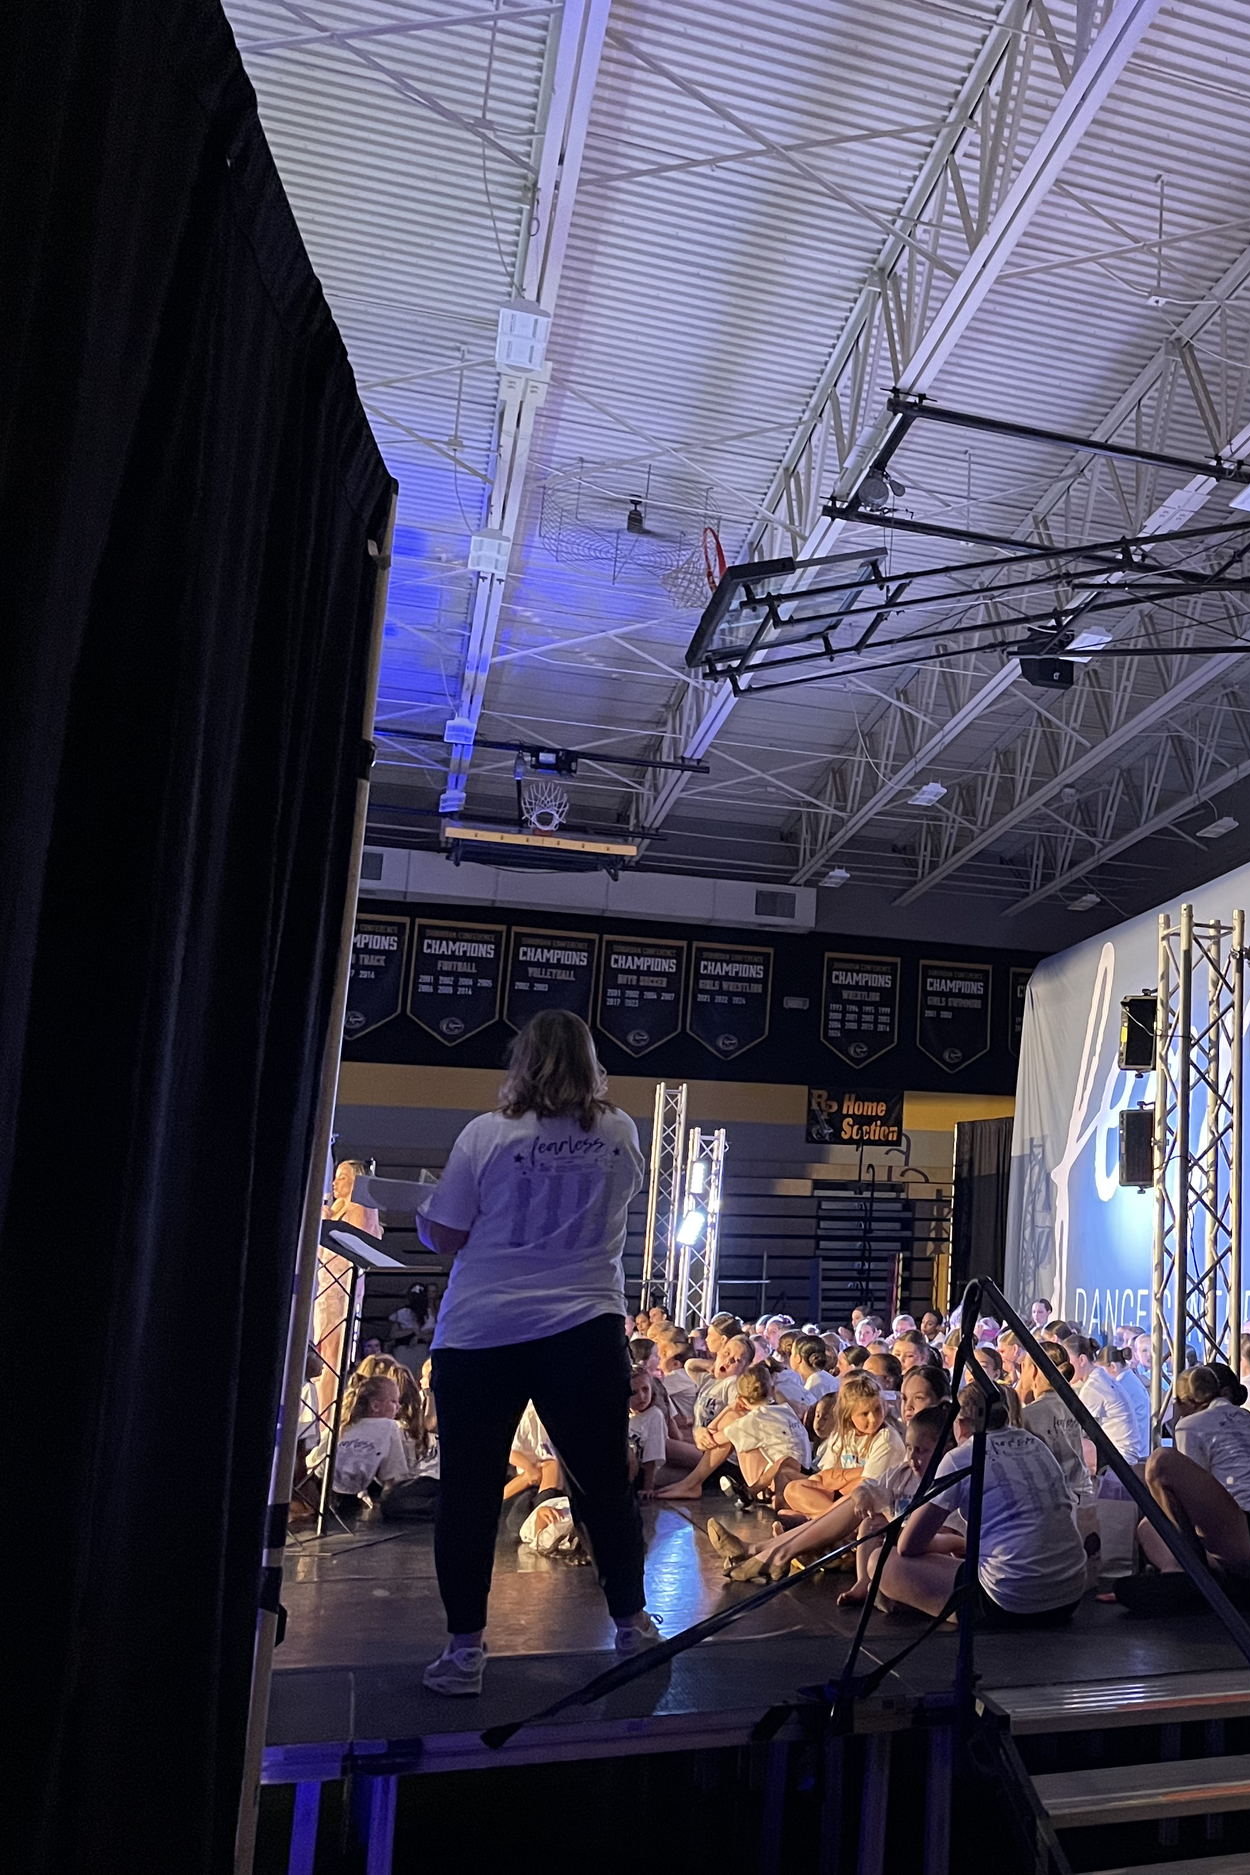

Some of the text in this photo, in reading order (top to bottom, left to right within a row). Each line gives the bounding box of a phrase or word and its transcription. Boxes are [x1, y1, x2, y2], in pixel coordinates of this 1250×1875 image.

[423, 939, 495, 958] CHAMPIONS
[518, 946, 588, 966] CHAMPIONS
[611, 955, 677, 973] CHAMPIONS
[700, 961, 764, 978] CHAMPIONS
[831, 970, 892, 988] CHAMPIONS
[926, 978, 985, 995] CHAMPIONS
[842, 1093, 887, 1117] Home
[841, 1117, 898, 1141] Section
[531, 1136, 607, 1166] fearless
